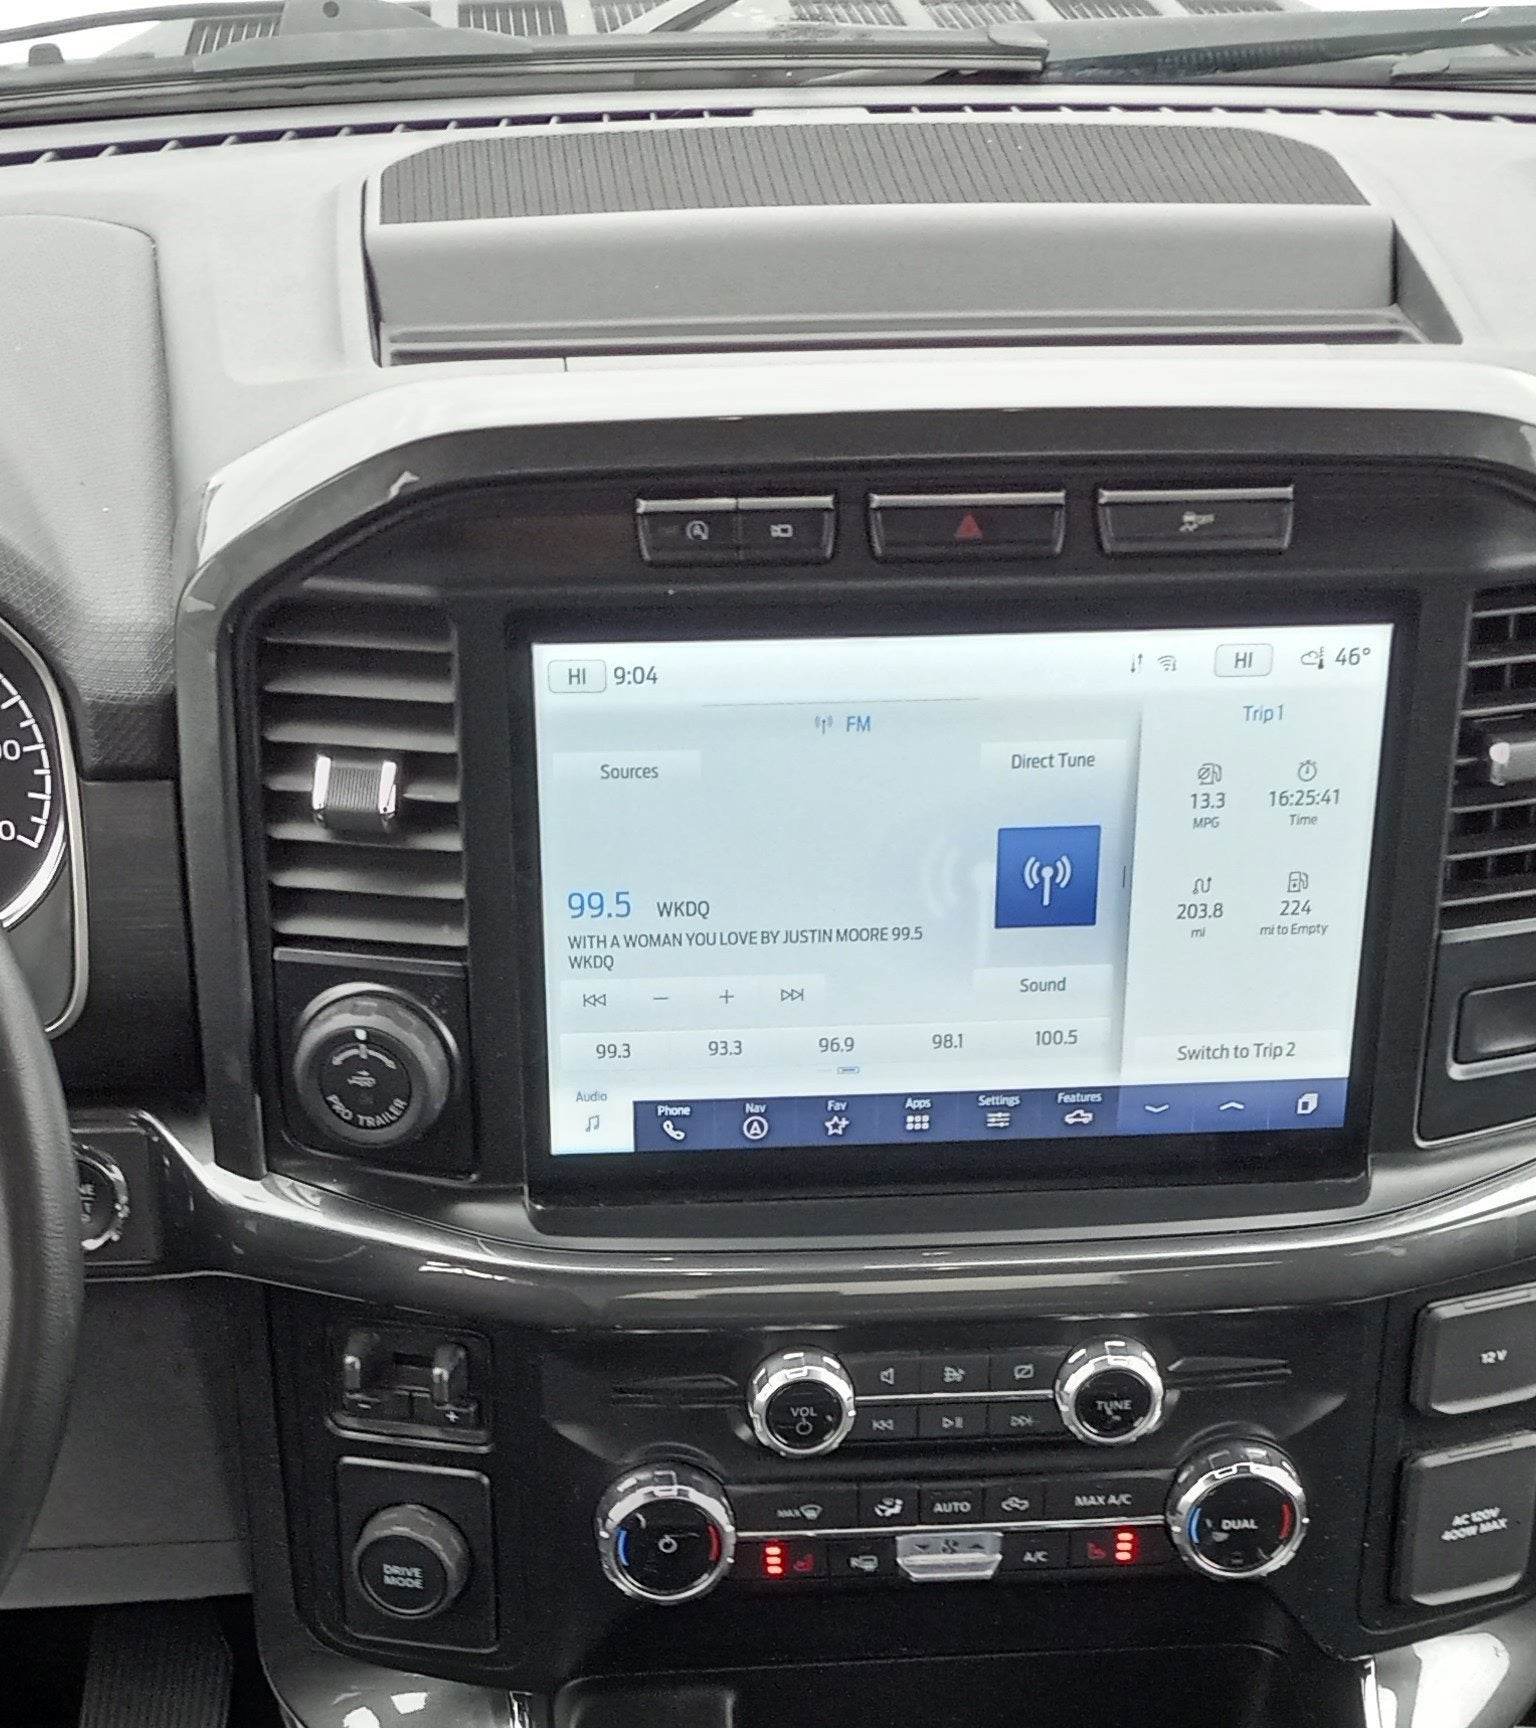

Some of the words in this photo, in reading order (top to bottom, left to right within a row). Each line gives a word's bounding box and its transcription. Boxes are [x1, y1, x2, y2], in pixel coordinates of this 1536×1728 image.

[1234, 651, 1253, 669] HI
[568, 668, 586, 685] HI
[613, 665, 658, 685] 9:04
[1243, 705, 1275, 723] Trip
[1277, 705, 1284, 720] 1
[846, 715, 872, 732] FM
[1011, 753, 1054, 769] Direct
[1058, 752, 1095, 768] Tune
[600, 763, 659, 780] Sources
[1190, 793, 1225, 809] 13.3
[1268, 789, 1341, 807] 16:25:41
[1193, 817, 1220, 829] MPG
[1289, 813, 1318, 826] Time
[567, 892, 631, 919] 99.5
[656, 901, 710, 919] WKDQ
[1176, 903, 1224, 920] 203.8
[1280, 900, 1312, 916] 224
[568, 935, 608, 949] WITH
[609, 934, 621, 948] A
[623, 932, 683, 948] WOMAN
[685, 931, 717, 947] YOU
[719, 930, 758, 946] LOVE
[760, 930, 781, 945] BY
[782, 928, 833, 945] JUSTIN
[835, 927, 889, 944] MOORE
[891, 926, 923, 942] 99.5
[1191, 926, 1206, 938] mi
[1260, 924, 1275, 936] mi
[1276, 924, 1288, 935] to
[1290, 922, 1328, 938] Empty
[568, 955, 615, 971] WKDQ
[1020, 977, 1066, 993] Sound
[818, 1037, 855, 1053] 96.9
[932, 1033, 963, 1050] 98.1
[1035, 1029, 1078, 1046] 100.5
[595, 1043, 631, 1060] 99.3
[708, 1040, 743, 1056] 93.3
[1177, 1044, 1230, 1061] Switch
[1233, 1044, 1249, 1059] to
[1250, 1043, 1284, 1062] Trip
[1285, 1042, 1296, 1057] 2
[576, 1090, 607, 1103] Audio
[906, 1097, 931, 1111] Apps
[977, 1094, 1021, 1109] Settings
[1057, 1091, 1103, 1104] Features
[326, 1094, 354, 1121] PRO
[357, 1098, 408, 1128] TRAILER
[657, 1104, 691, 1117] Phone
[745, 1102, 766, 1114] Nav
[827, 1100, 847, 1112] Fav
[790, 1406, 817, 1418] VOL
[1096, 1400, 1132, 1413] TUNE
[933, 1501, 971, 1514] AUTO
[1074, 1495, 1106, 1507] MAX
[1107, 1493, 1132, 1506] A/C
[1221, 1518, 1258, 1531] DUAL
[1023, 1550, 1048, 1563] A/C
[383, 1563, 422, 1578] DRIVE
[383, 1575, 424, 1590] MODE
